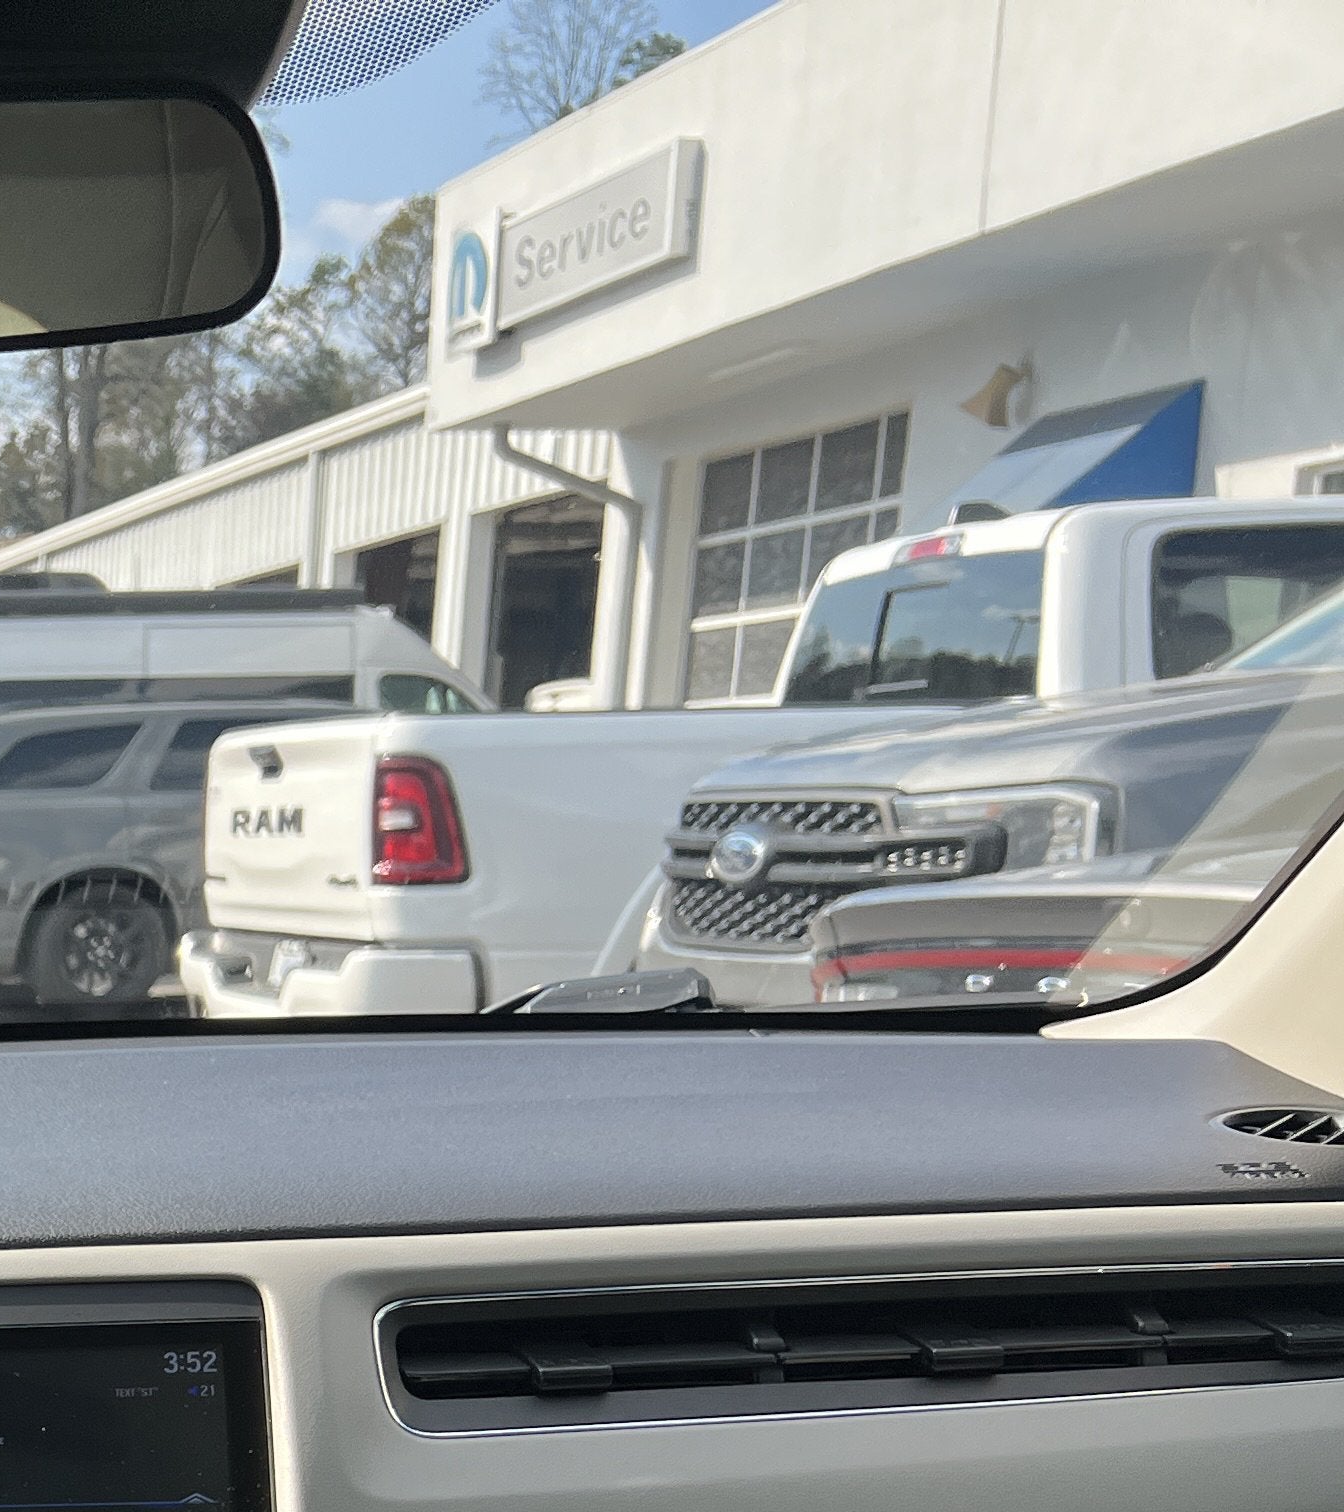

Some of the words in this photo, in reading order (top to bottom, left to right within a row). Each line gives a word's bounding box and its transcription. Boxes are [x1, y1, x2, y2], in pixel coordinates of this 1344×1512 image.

[515, 196, 651, 289] Service
[232, 807, 304, 835] RAM
[163, 1351, 218, 1374] 3:52
[200, 1384, 215, 1397] 21
